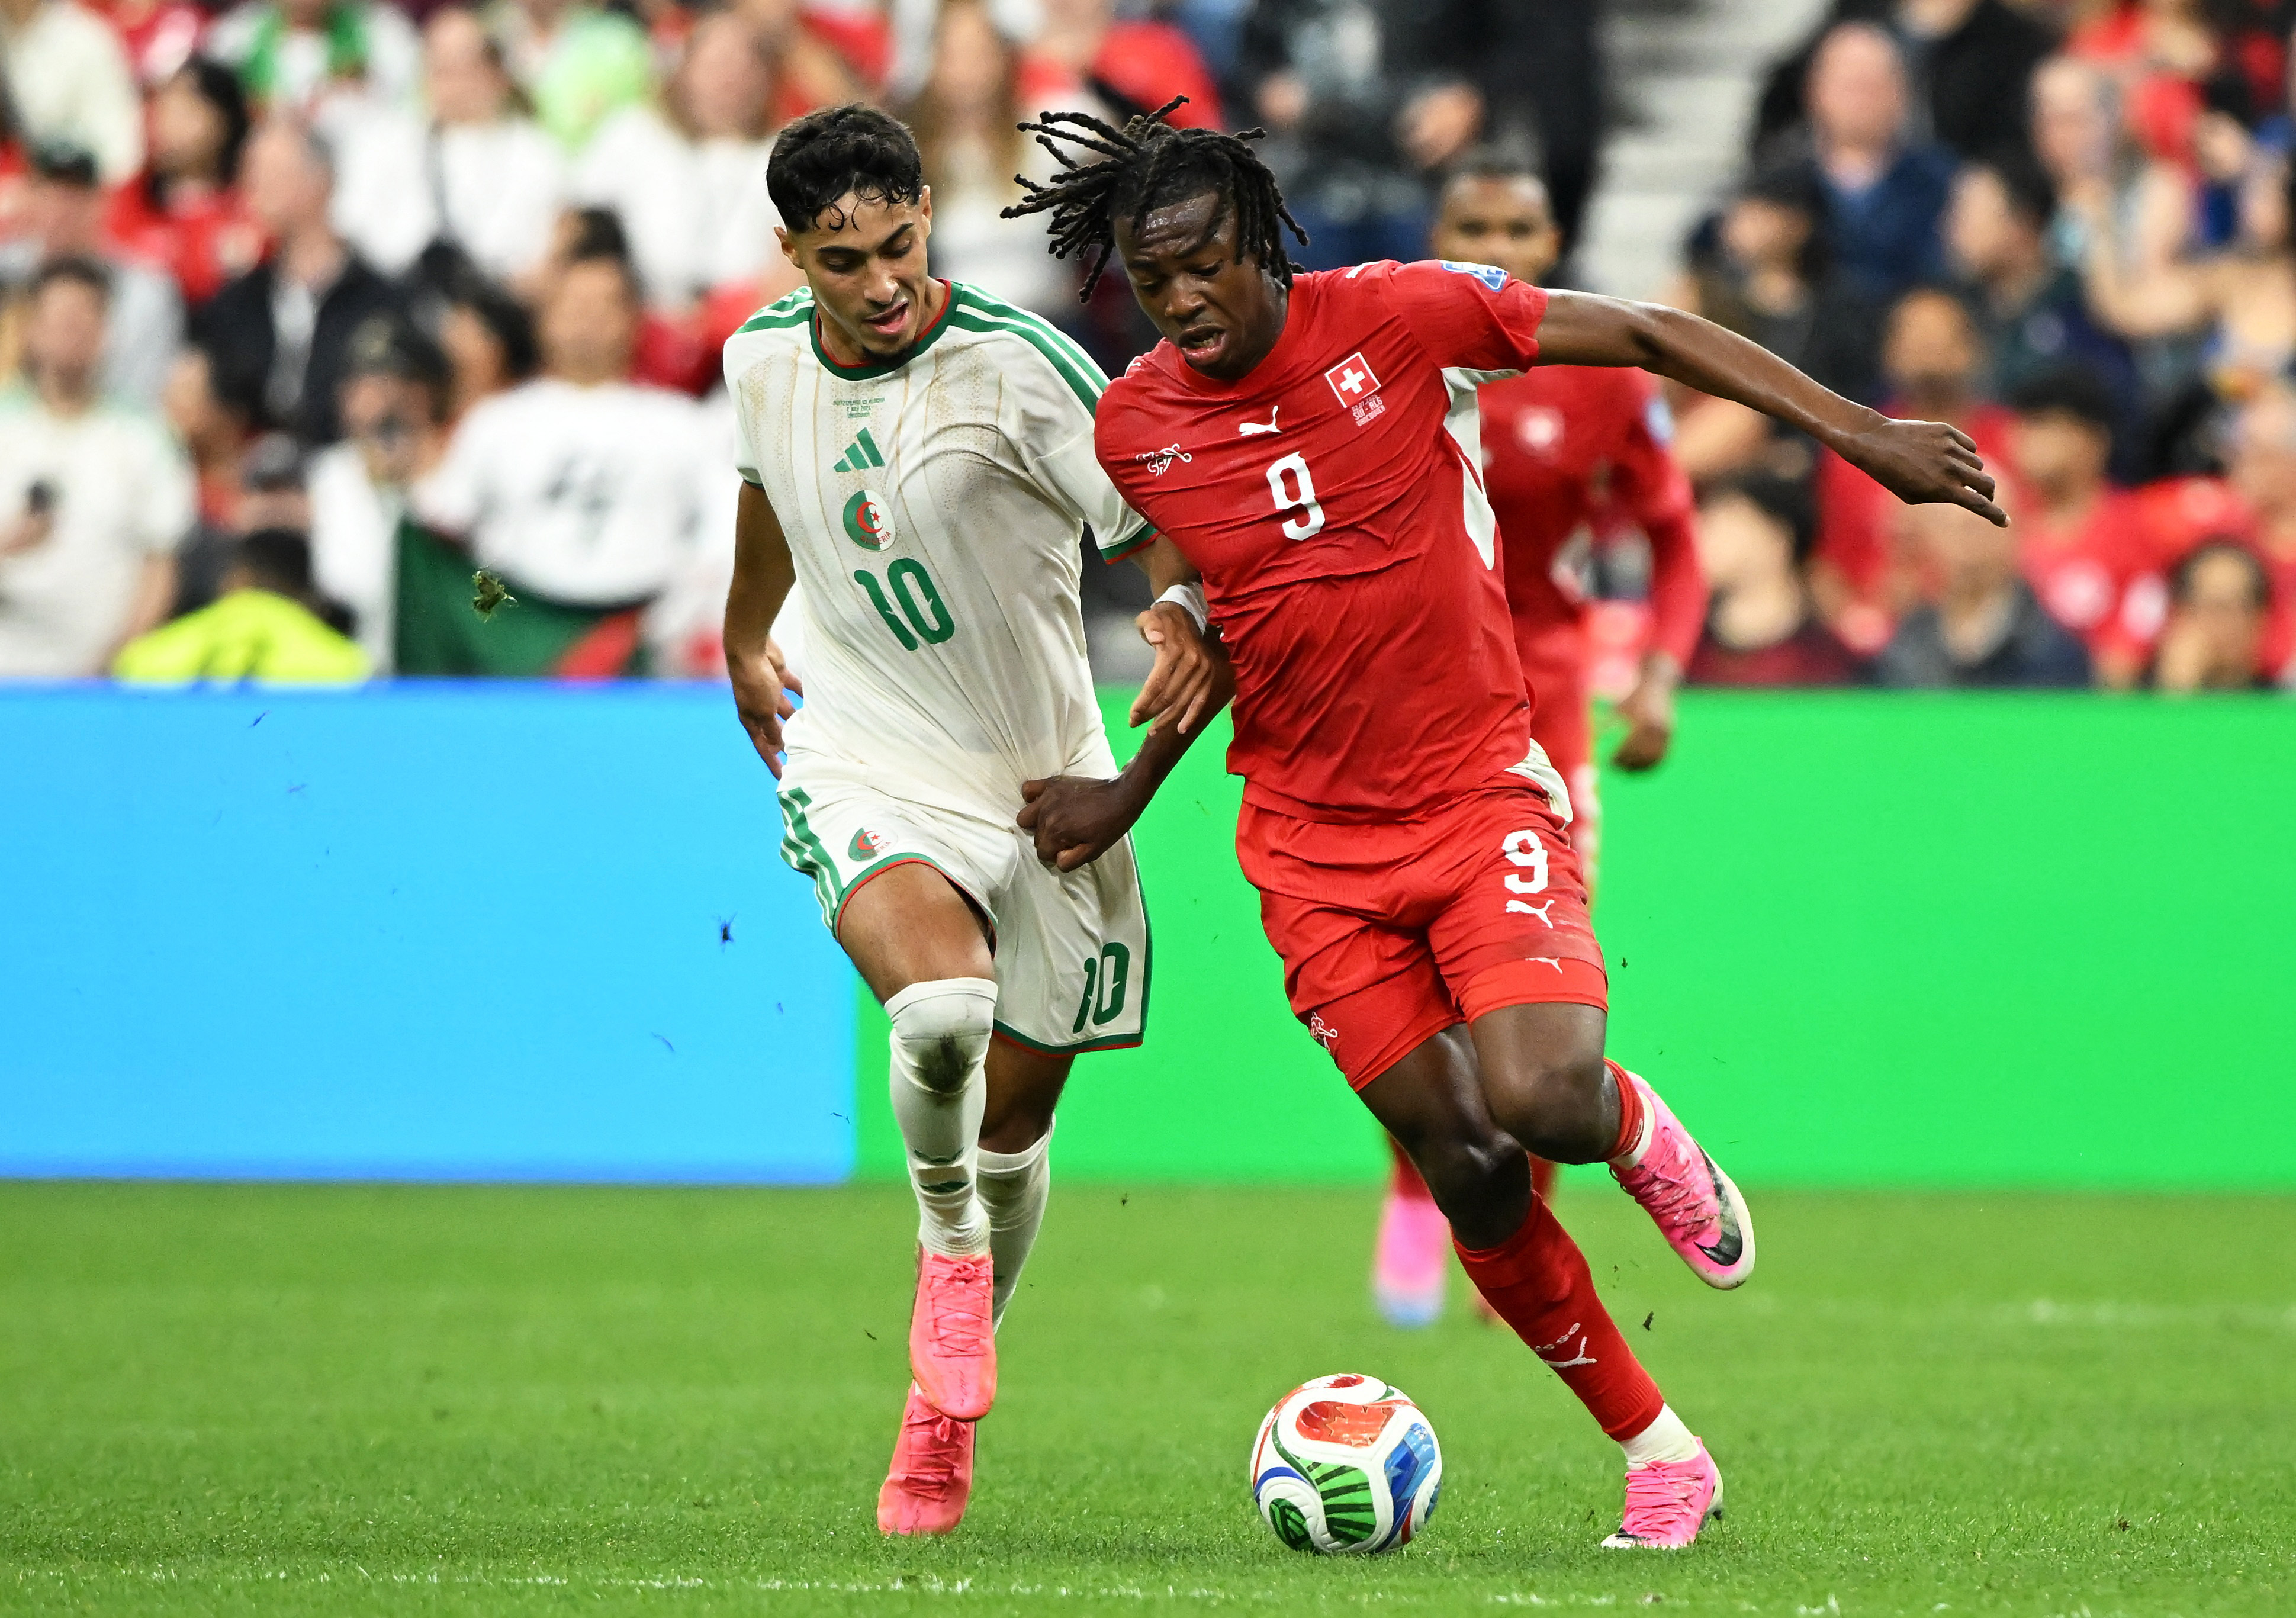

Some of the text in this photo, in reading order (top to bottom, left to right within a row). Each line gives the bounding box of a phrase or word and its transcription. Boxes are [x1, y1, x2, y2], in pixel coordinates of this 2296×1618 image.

[1352, 408, 1366, 420] SUI
[1368, 396, 1383, 410] ALG
[1266, 451, 1326, 541] 9
[860, 530, 891, 545] ERIA
[853, 558, 955, 651] 10
[1501, 829, 1549, 895] 9
[1072, 941, 1130, 1034] 10
